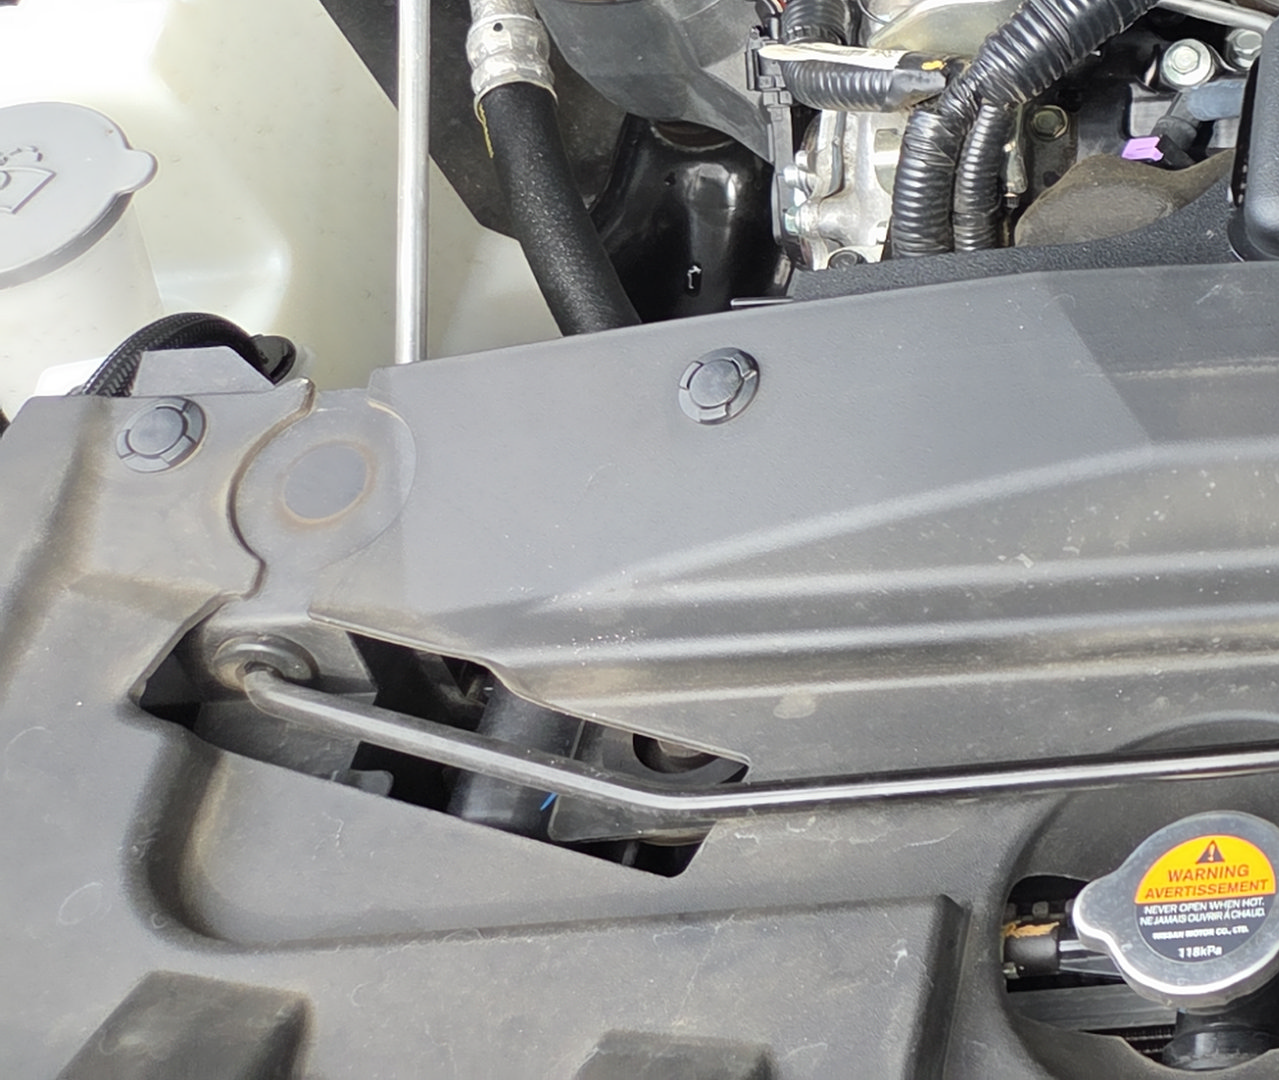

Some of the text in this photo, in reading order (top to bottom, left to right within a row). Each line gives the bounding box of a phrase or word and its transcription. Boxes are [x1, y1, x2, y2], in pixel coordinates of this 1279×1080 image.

[1168, 864, 1250, 883] WARNING
[1144, 879, 1269, 900] AVERTISSEMENT
[1144, 896, 1264, 915] NEVER OPEN WHEN HOT.
[1139, 916, 1152, 926] NE
[1153, 913, 1186, 925] JAMAIS
[1187, 911, 1222, 922] OUVRIR
[1185, 927, 1214, 937] MOTOR
